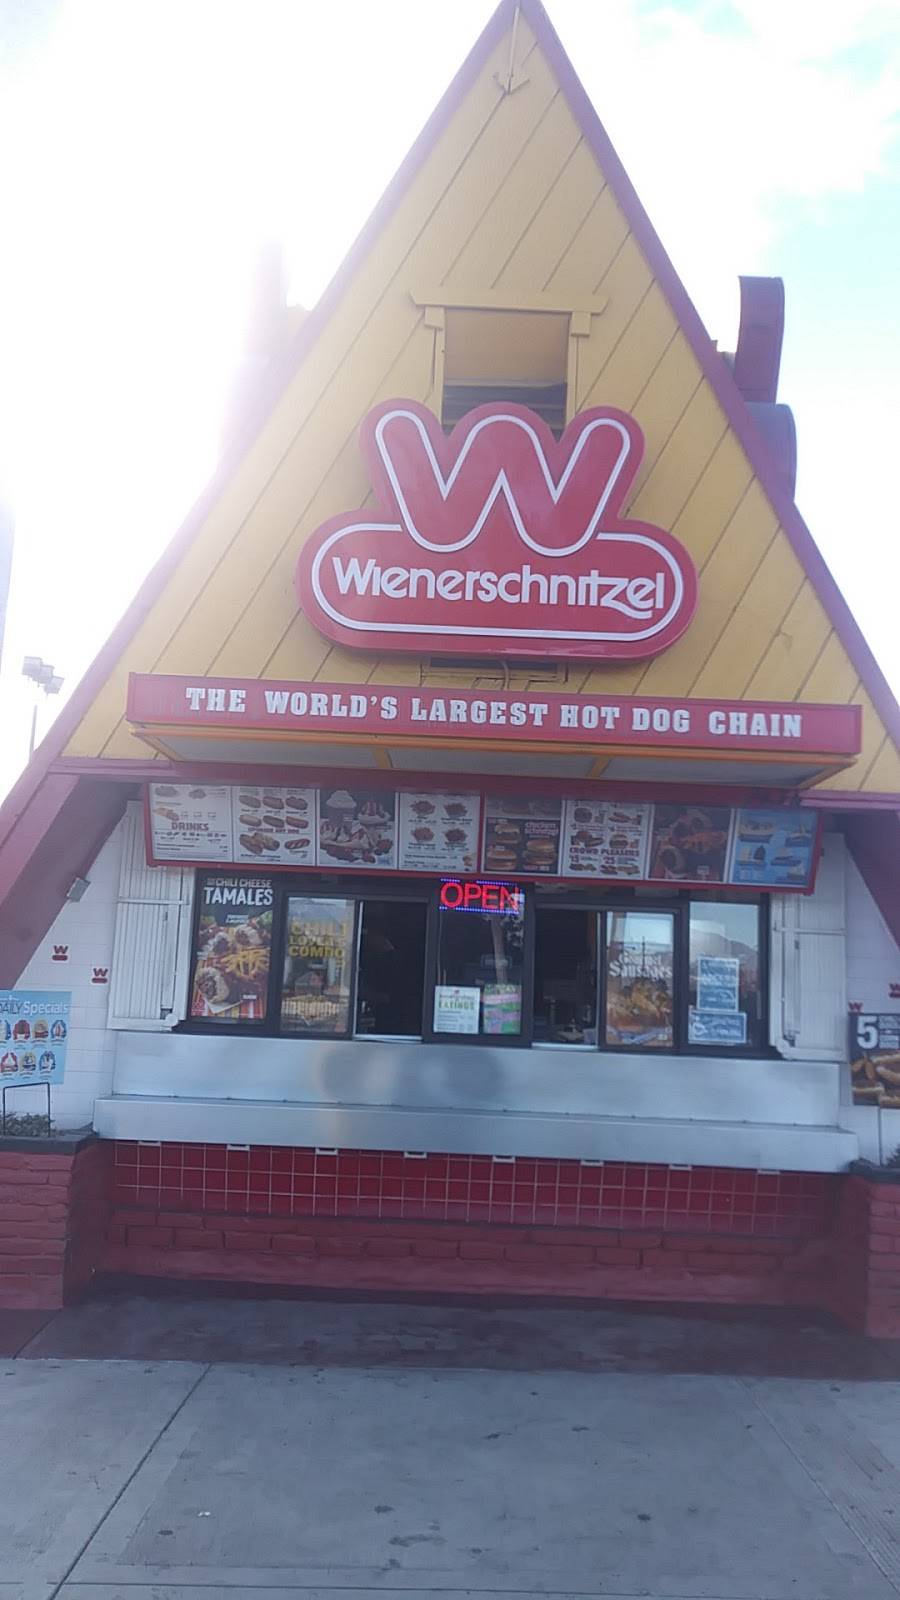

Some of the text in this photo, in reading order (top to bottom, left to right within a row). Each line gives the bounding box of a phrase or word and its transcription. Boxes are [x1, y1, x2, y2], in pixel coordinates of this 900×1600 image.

[332, 556, 665, 619] Wienerschnitzel
[185, 687, 803, 738] THE WORLD'S LARGEST HOT DOG CHAIN
[171, 821, 210, 832] DRINKS
[239, 879, 272, 888] CHEESE
[204, 886, 274, 906] TAMALES
[440, 882, 519, 911] OPEN
[23, 1000, 69, 1016] Specials
[857, 1015, 879, 1049] 5
